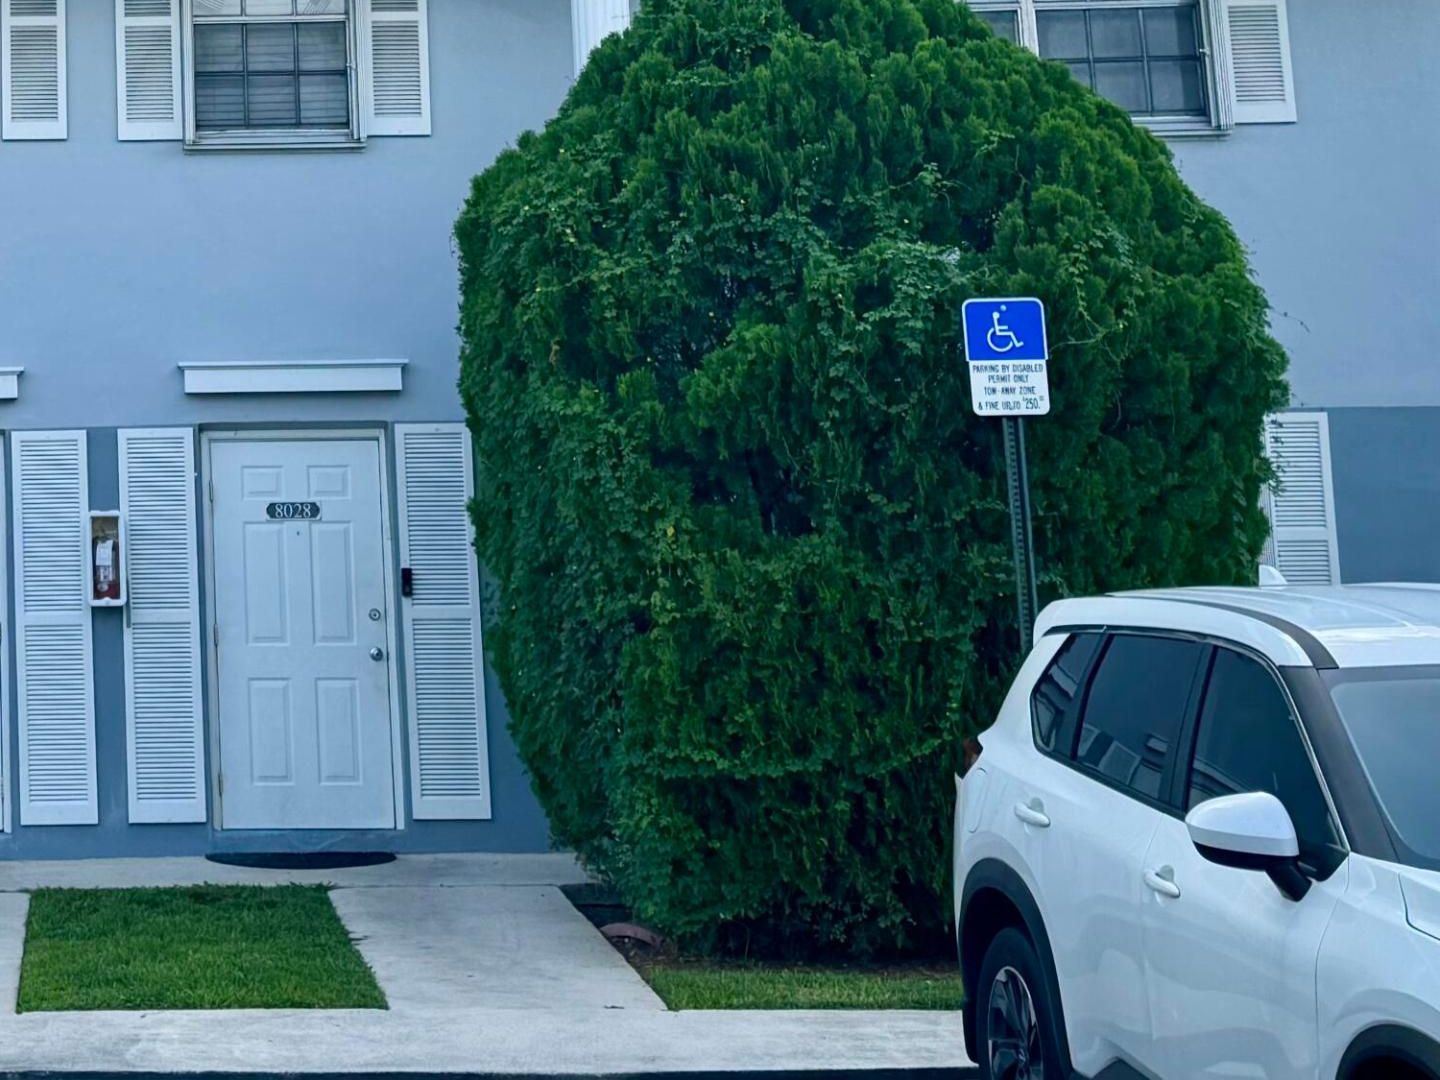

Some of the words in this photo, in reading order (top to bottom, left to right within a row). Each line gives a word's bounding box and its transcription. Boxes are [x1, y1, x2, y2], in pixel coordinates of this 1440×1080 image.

[972, 365, 999, 373] PARKING
[1001, 365, 1009, 373] BY
[1012, 364, 1043, 372] DISABLED
[988, 375, 1011, 383] PERMIT
[1013, 375, 1029, 383] ONLY
[1019, 386, 1036, 395] ZONE
[985, 401, 999, 410] FINE
[274, 503, 311, 518] 8028
